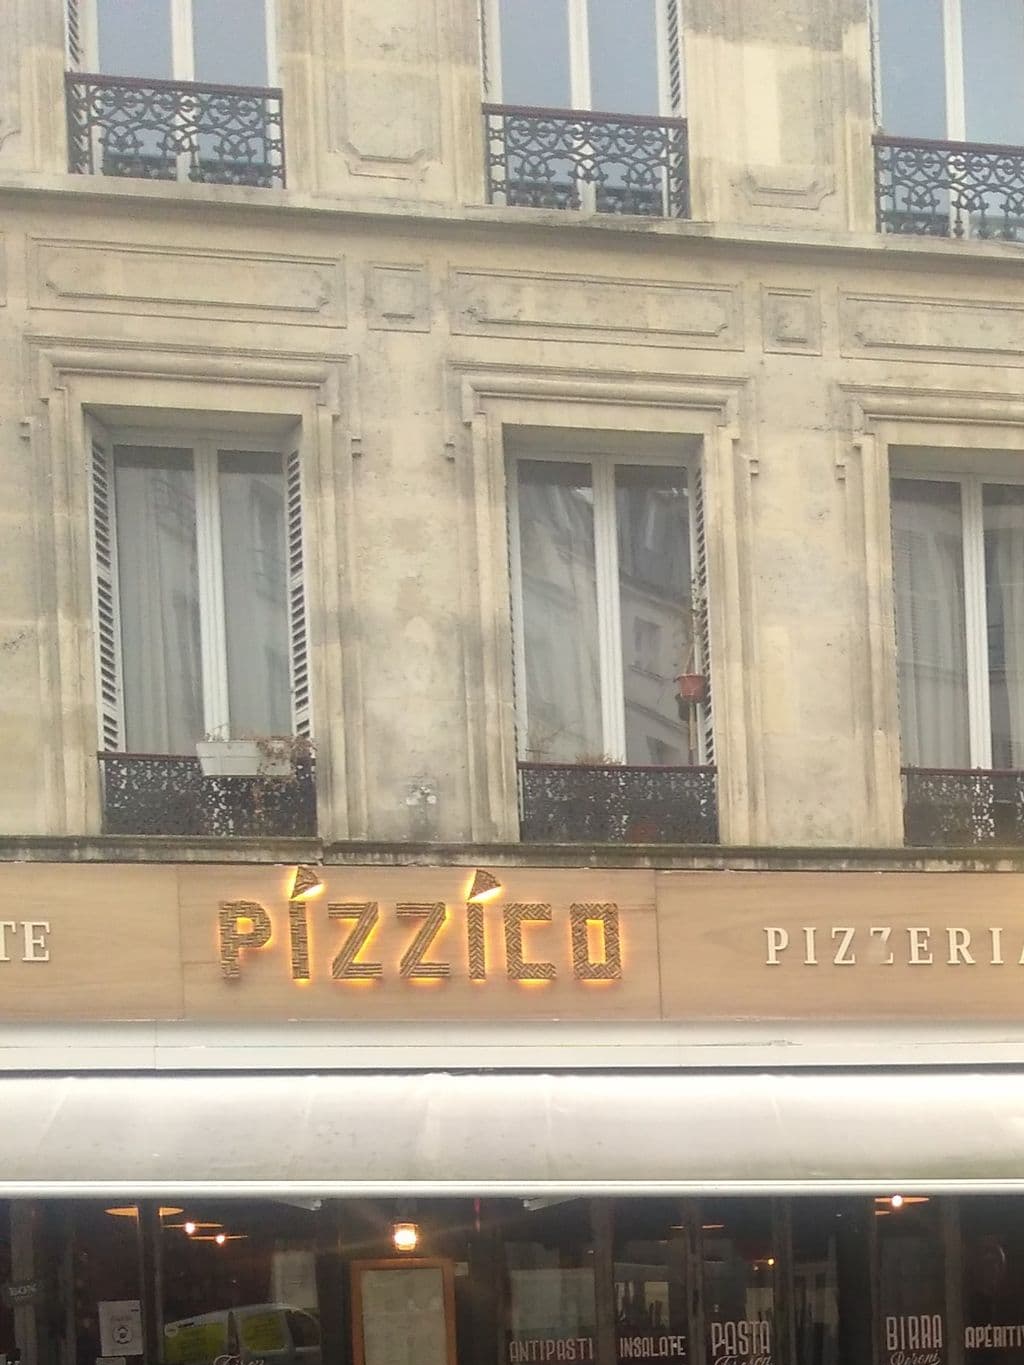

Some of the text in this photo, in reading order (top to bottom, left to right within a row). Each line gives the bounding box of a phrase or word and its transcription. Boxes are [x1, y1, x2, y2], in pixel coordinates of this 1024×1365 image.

[620, 1335, 687, 1358] INSALATE
[711, 1320, 770, 1356] PASTA
[886, 1314, 943, 1351] BIRRA
[509, 1338, 594, 1362] ANTIPASTI
